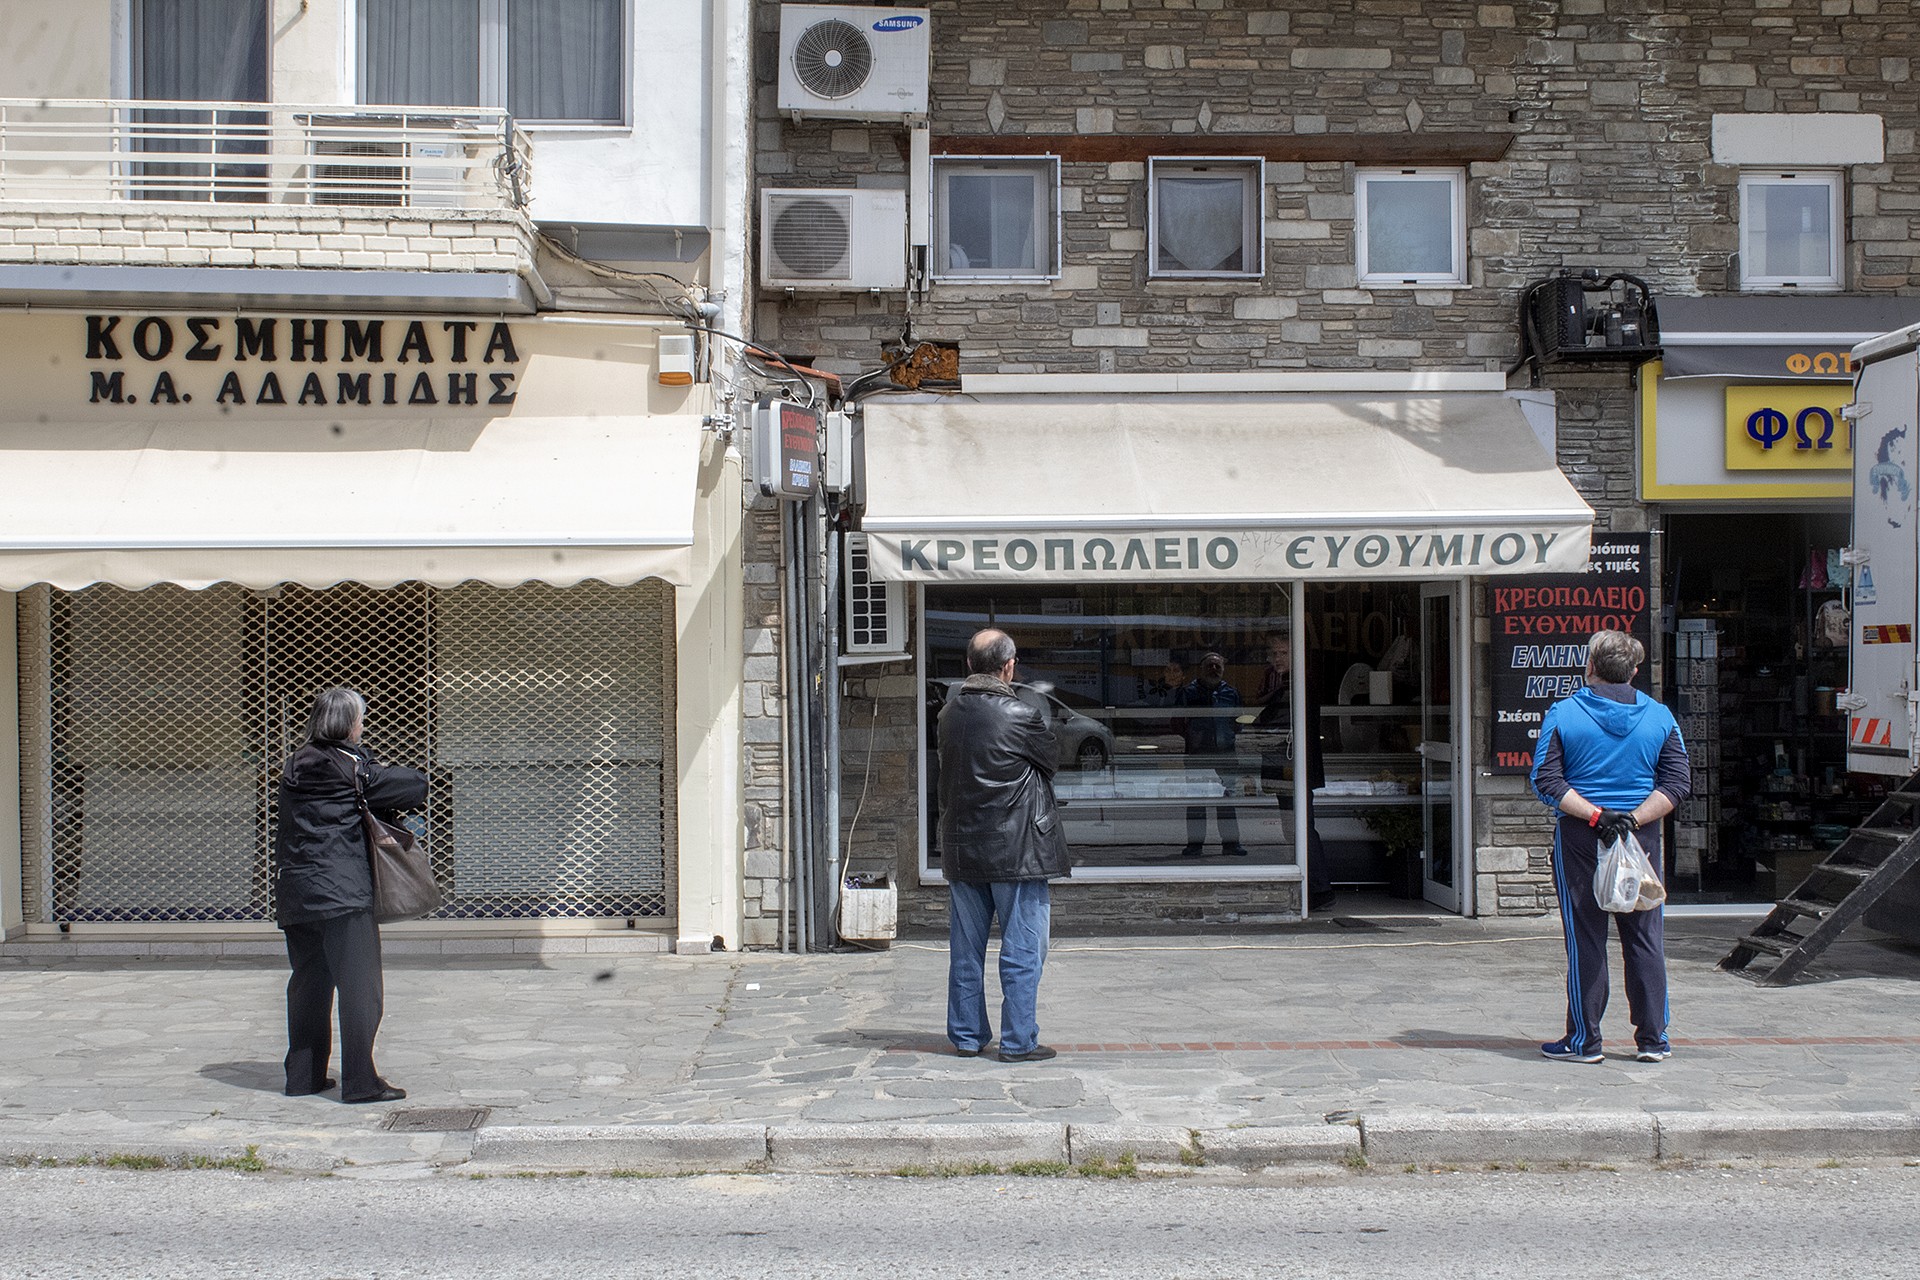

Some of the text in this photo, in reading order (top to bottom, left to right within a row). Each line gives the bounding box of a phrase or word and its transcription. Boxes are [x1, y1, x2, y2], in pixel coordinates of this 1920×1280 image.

[878, 20, 918, 28] SAMSUNG
[85, 316, 519, 363] ΚΟΣΜΗΜΑΤΑ
[1786, 352, 1851, 374] ΦΩΤ
[89, 371, 518, 405] Μ. Α. ΑΔΑΜΙΔΗΣ
[1746, 406, 1852, 449] ΦΩ
[900, 537, 1239, 572] ΚΡΕΟΠΩΛΕΙΟ
[1285, 532, 1558, 569] ΕΥΘΥΜΙΟΥ
[1590, 542, 1640, 555] οιότητα
[1588, 557, 1640, 574] ες τιμές
[1494, 586, 1645, 614] ΚΡΕΟΠΩΛΕΙΟ
[1504, 614, 1636, 635] ΕΥΘΥΜΙΟΥ
[1511, 645, 1590, 668] ΕΛΛΗΝΙ
[1525, 675, 1584, 698] ΚΡΕΑ
[1497, 709, 1541, 723] Σχέση
